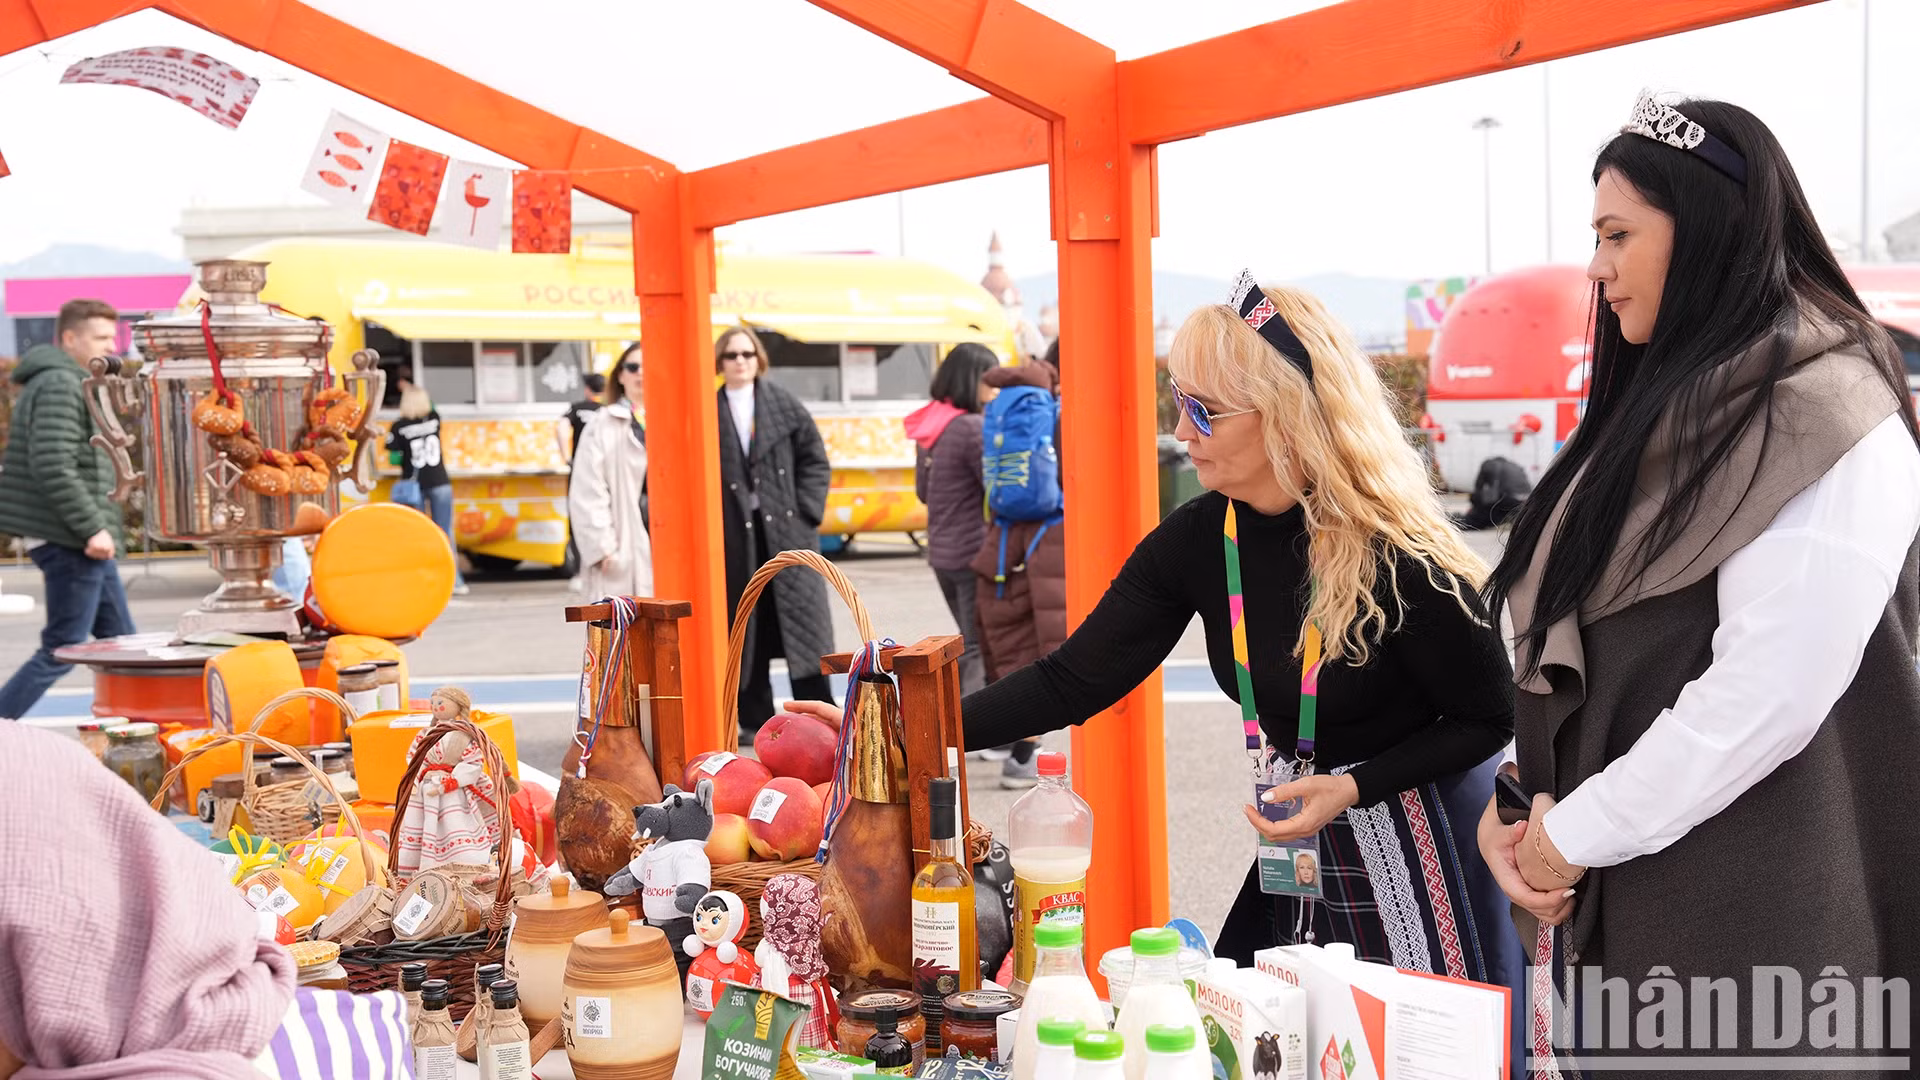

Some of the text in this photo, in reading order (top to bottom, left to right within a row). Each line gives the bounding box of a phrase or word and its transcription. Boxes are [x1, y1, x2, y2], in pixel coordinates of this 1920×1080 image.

[1052, 891, 1080, 905] КВАС
[731, 995, 744, 1007] 250
[1197, 983, 1243, 1018] МОЛОКО
